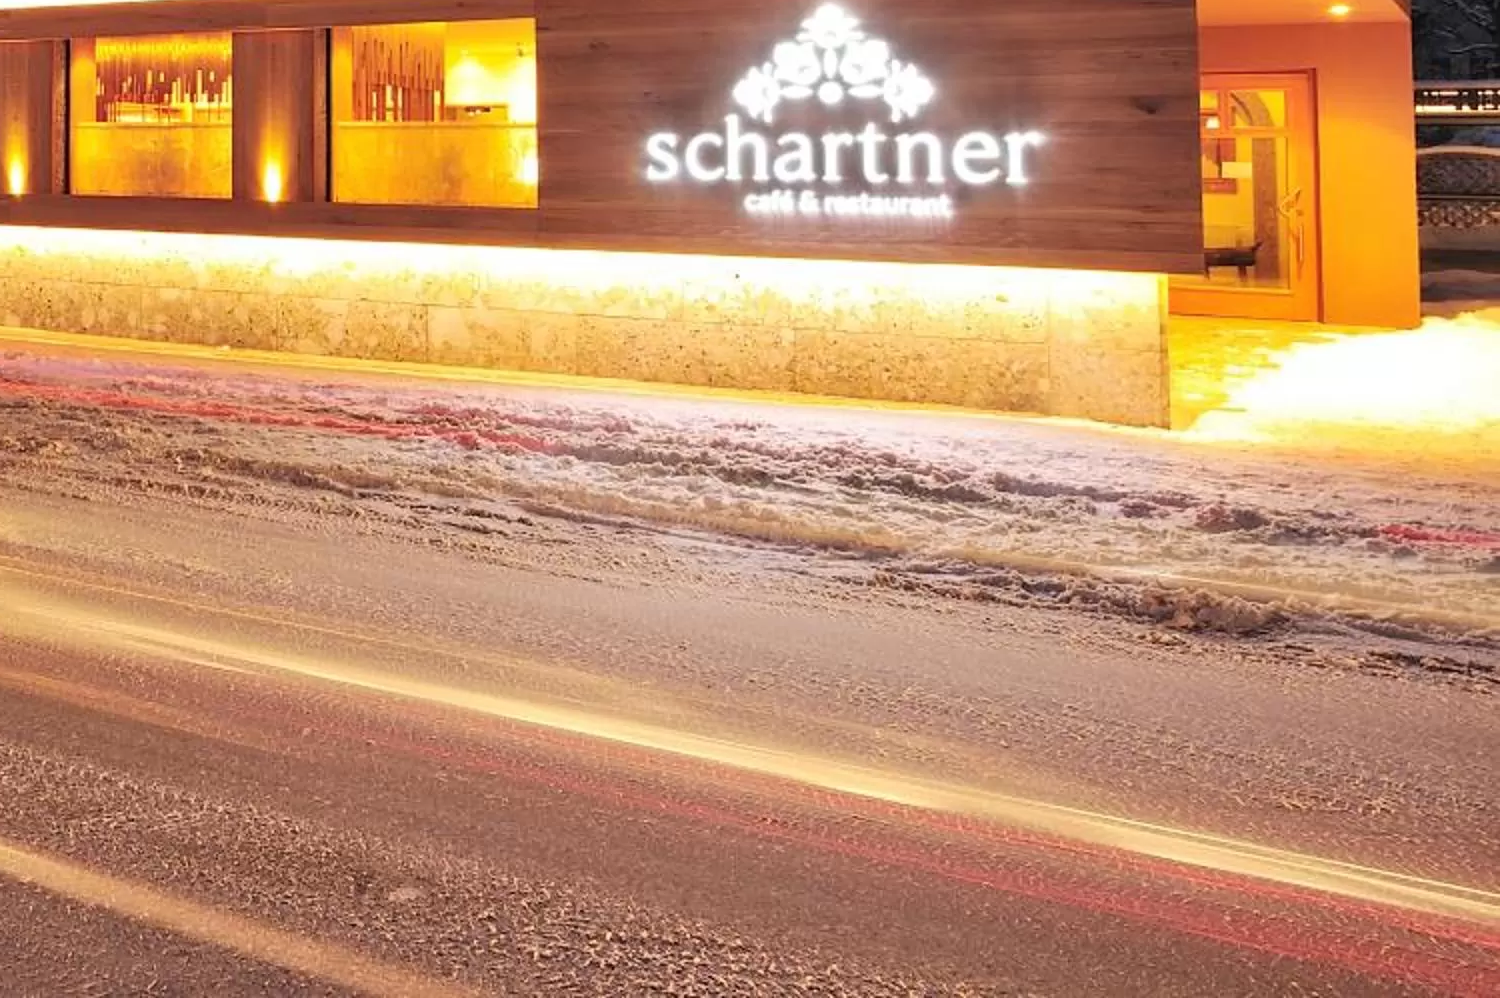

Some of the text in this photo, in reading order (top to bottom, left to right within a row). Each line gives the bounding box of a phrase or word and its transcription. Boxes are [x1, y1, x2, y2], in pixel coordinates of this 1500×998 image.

[645, 113, 1048, 185] schartner
[798, 189, 819, 214] &
[823, 191, 954, 219] restaurant
